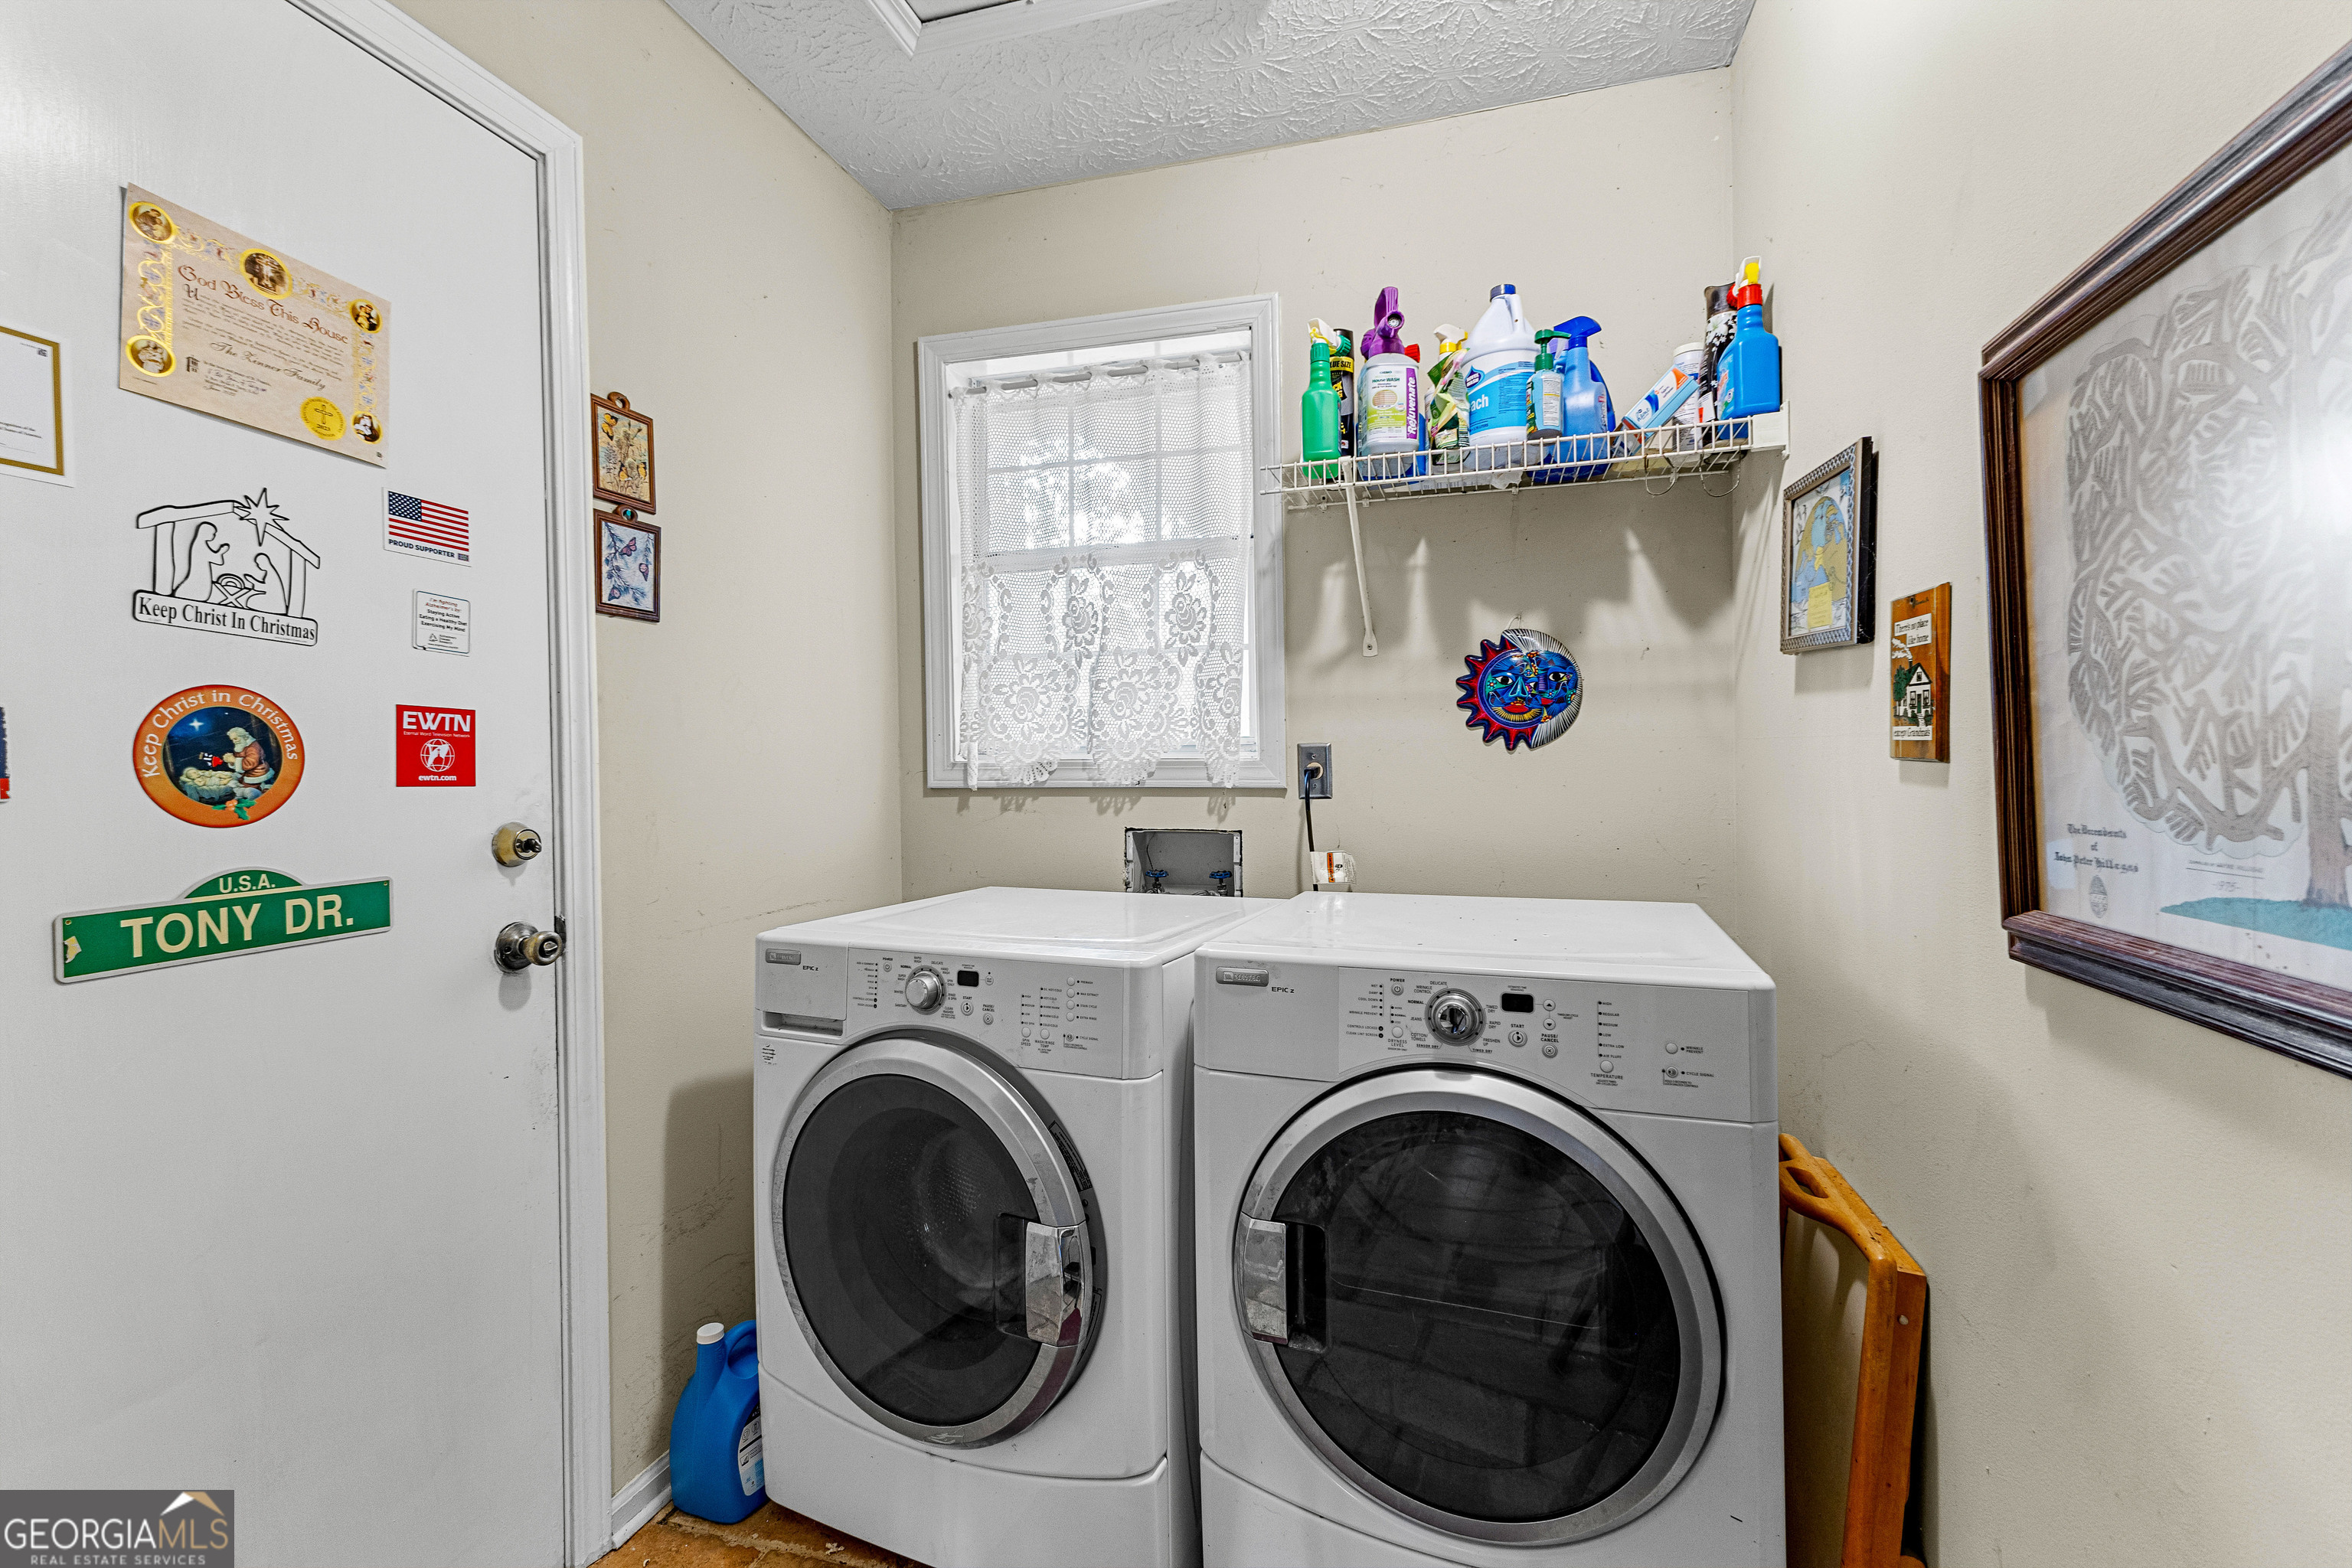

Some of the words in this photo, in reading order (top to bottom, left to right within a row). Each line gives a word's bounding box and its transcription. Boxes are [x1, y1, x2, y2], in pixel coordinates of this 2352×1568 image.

[178, 265, 217, 291] God
[221, 280, 264, 310] Bless
[267, 299, 299, 324] This
[303, 317, 349, 344] House
[211, 342, 237, 357] The
[284, 368, 326, 390] Family
[1406, 377, 1416, 435] Rejuvenate
[1471, 394, 1489, 412] ach
[388, 539, 414, 550] PROUD
[416, 544, 455, 558] SUPPORTER
[139, 596, 177, 623] Keep
[182, 604, 227, 626] Christ
[231, 612, 245, 629] In
[250, 615, 315, 640] Christmas
[421, 621, 445, 629] Exercising
[1896, 622, 1910, 634] There's
[1911, 622, 1916, 630] no
[1916, 619, 1929, 631] place
[1916, 634, 1929, 643] home
[403, 710, 471, 732] EWTN
[142, 733, 162, 778] Keep
[152, 691, 206, 728] Christ
[212, 690, 230, 702] in
[239, 694, 298, 760] Christmas
[219, 874, 276, 893] U.S.A.
[120, 903, 262, 958] TONY
[285, 893, 354, 935] DR.
